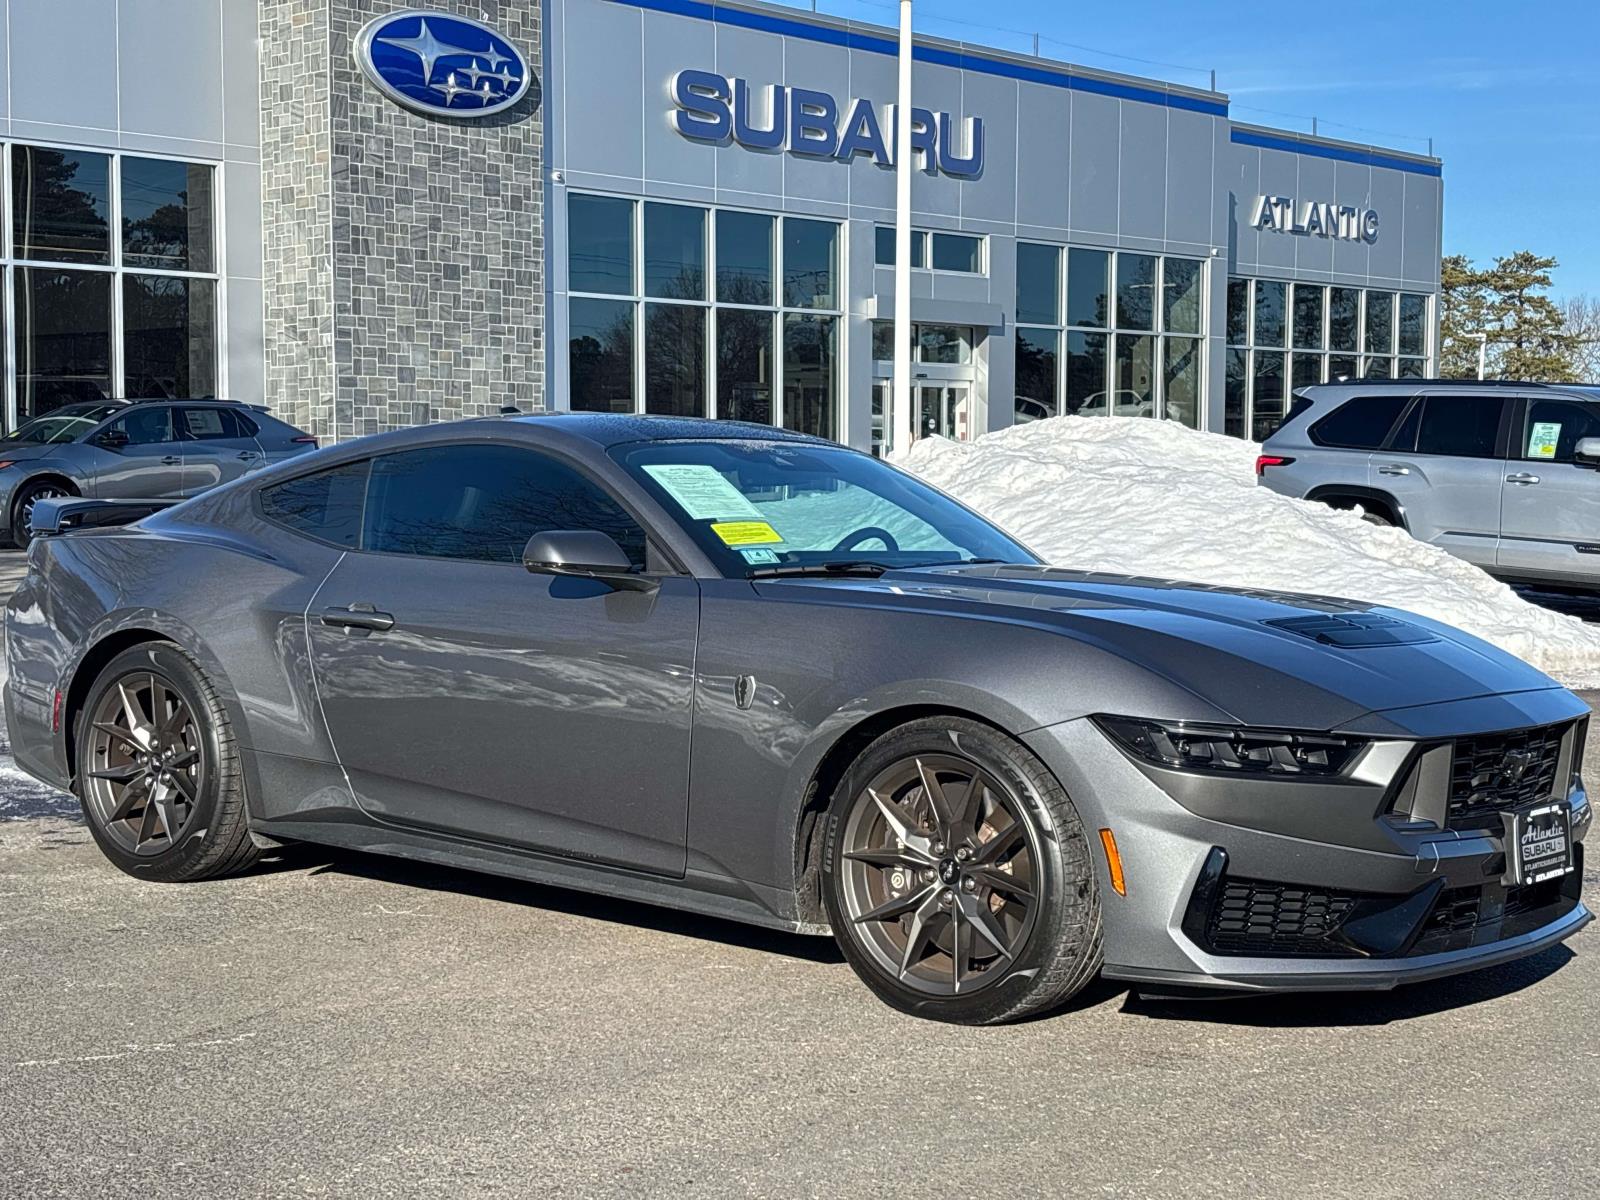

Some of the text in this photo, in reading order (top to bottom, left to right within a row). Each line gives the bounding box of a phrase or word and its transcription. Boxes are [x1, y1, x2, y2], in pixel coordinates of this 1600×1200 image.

[671, 69, 985, 177] SUBARU
[1251, 195, 1379, 245] ATLANTIC
[1521, 820, 1565, 845] Atlantic
[1523, 839, 1557, 858] SUBARU
